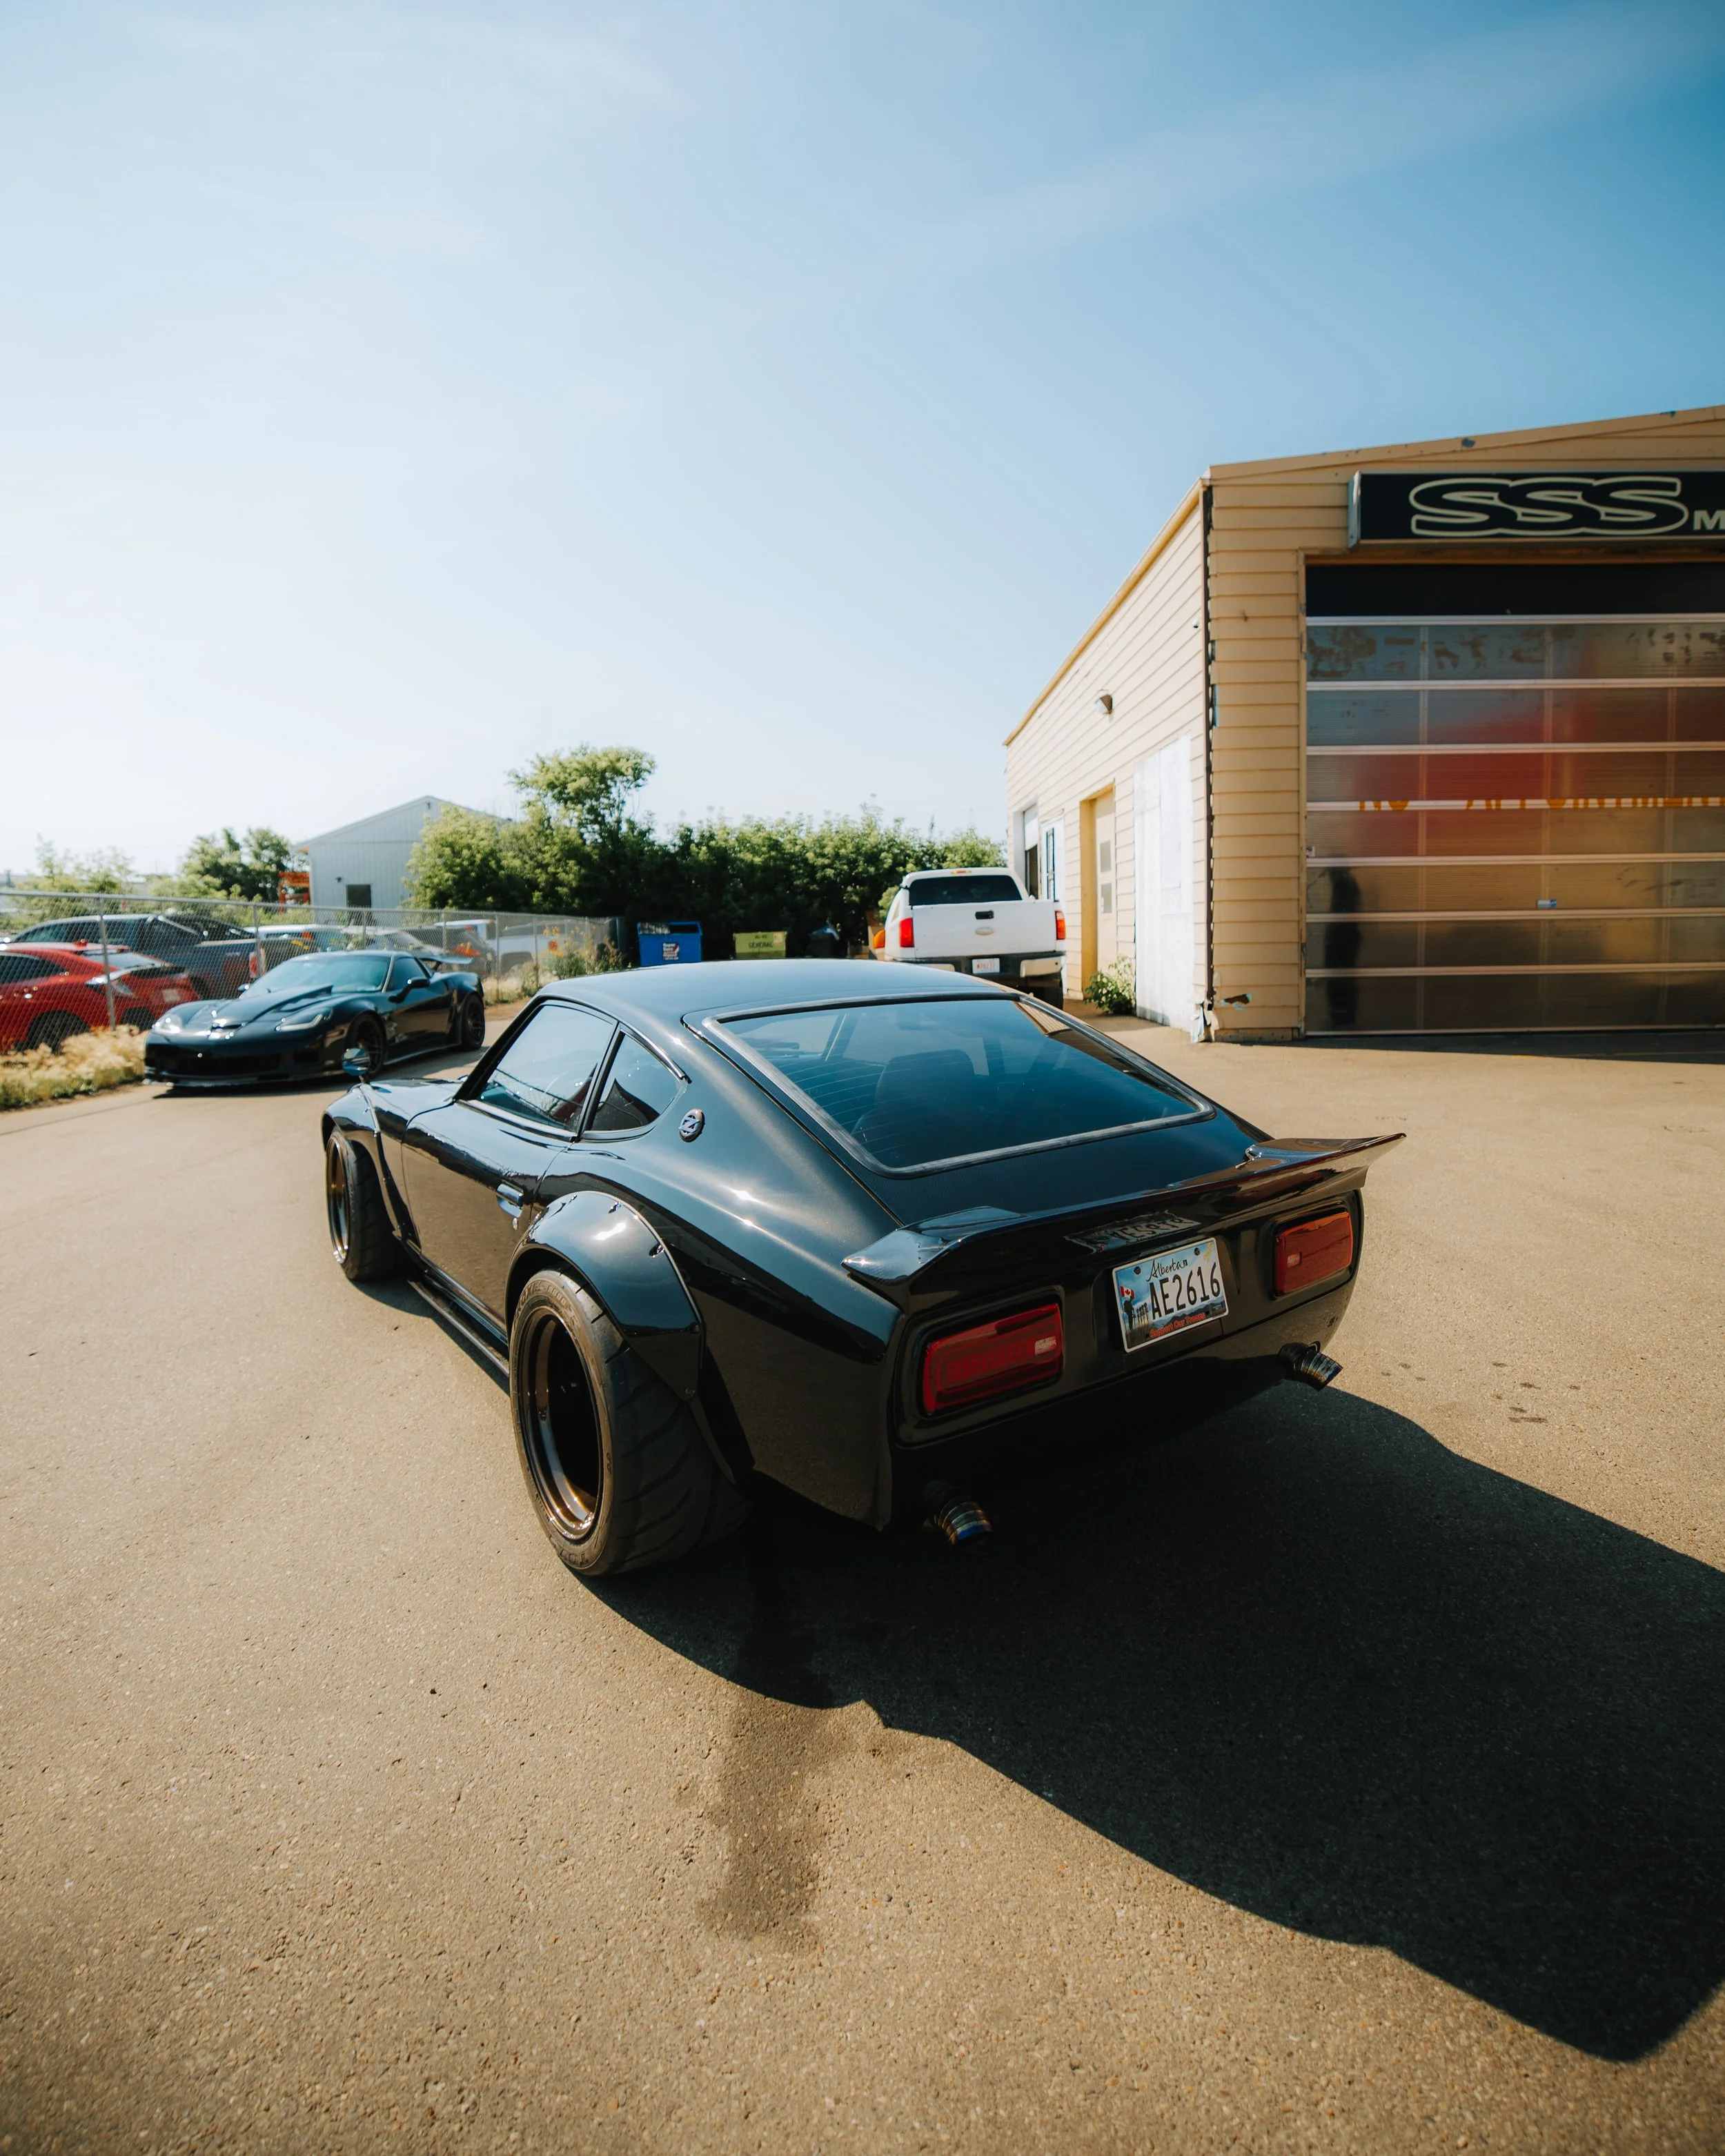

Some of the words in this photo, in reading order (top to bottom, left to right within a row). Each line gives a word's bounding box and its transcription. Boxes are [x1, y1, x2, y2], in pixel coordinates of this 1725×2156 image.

[1409, 476, 1689, 537] SSS
[1145, 1258, 1188, 1282] Alberta
[1149, 1262, 1221, 1321] AE2616
[1150, 1323, 1174, 1338] Support
[1173, 1319, 1185, 1329] Our
